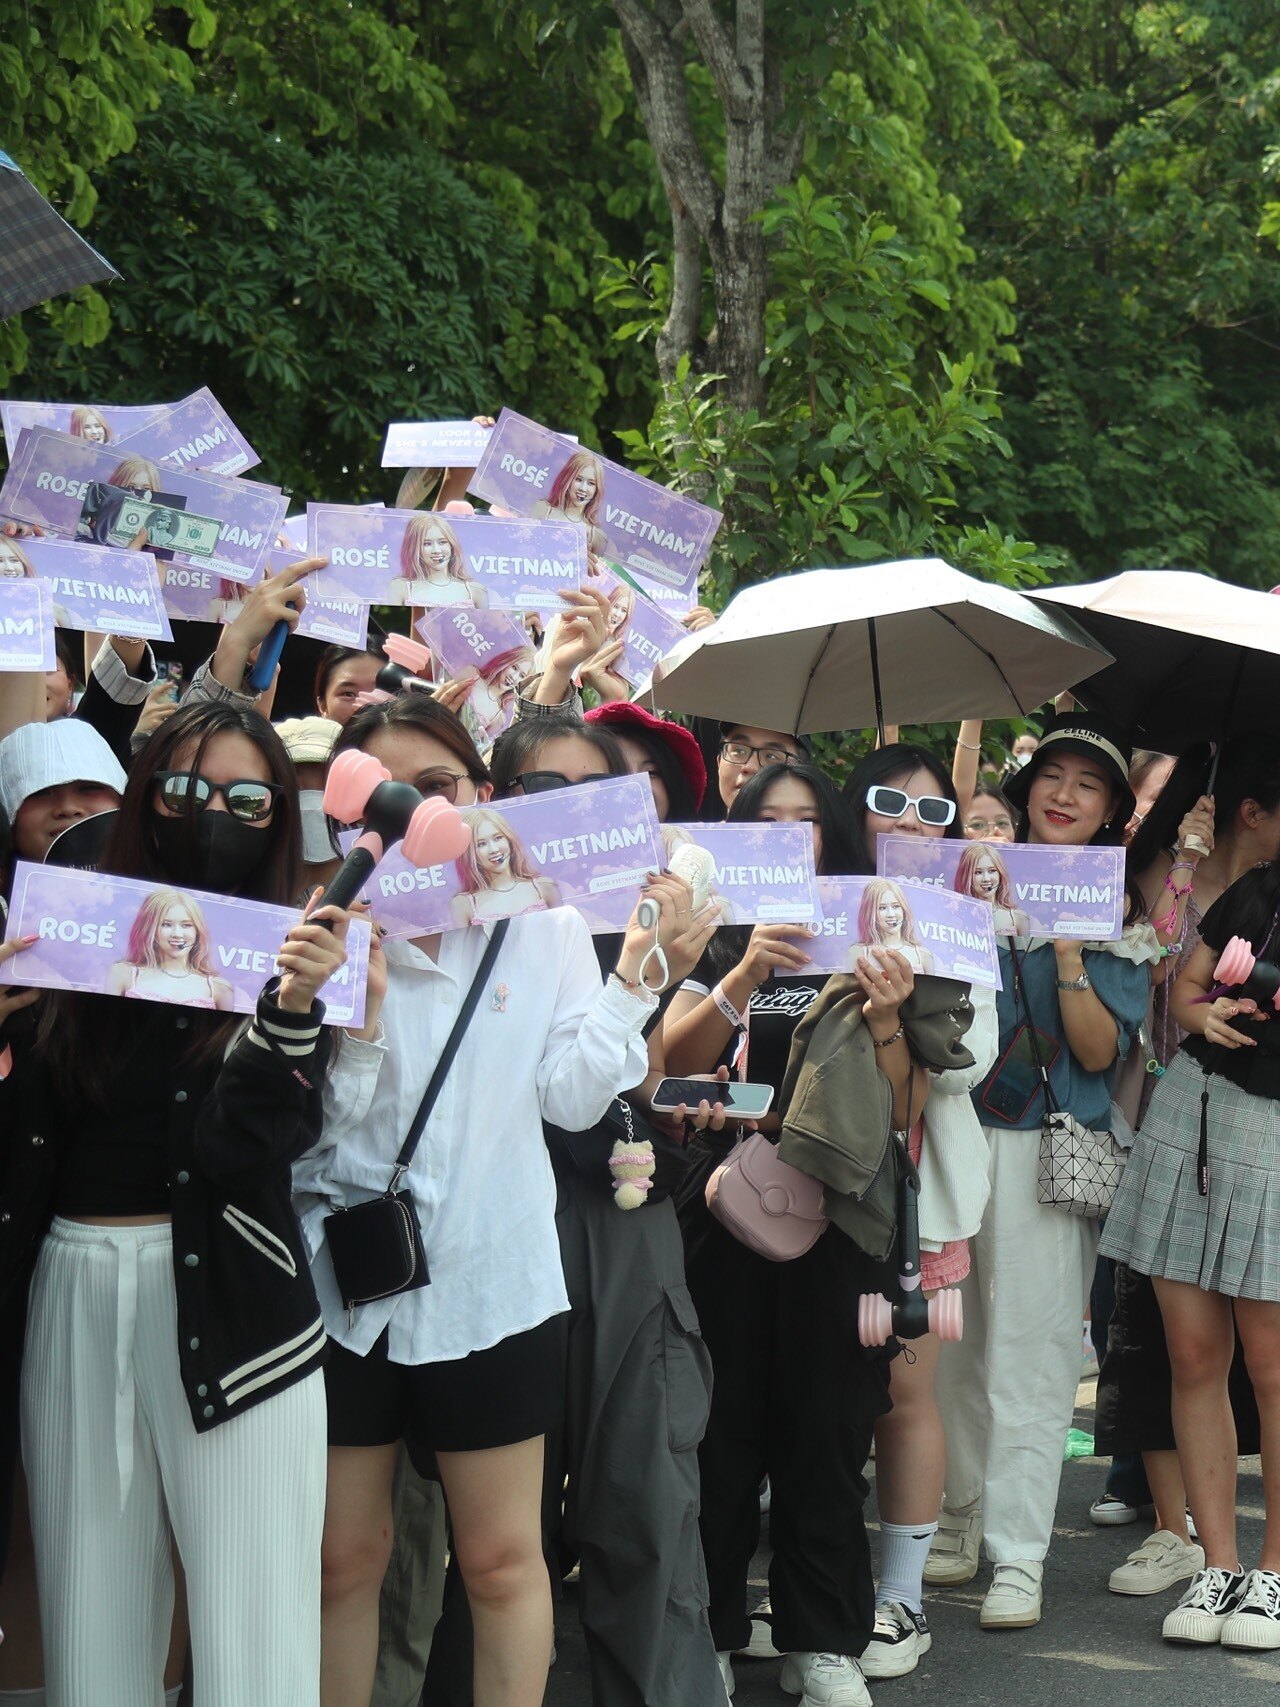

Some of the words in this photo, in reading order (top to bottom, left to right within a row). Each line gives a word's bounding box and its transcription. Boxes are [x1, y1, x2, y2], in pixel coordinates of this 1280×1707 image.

[500, 454, 550, 489] ROSÉ
[604, 504, 696, 558] VIETNAM
[331, 545, 390, 569] ROSÉ
[469, 555, 575, 579] VIETNAM
[452, 612, 495, 657] ROSÉ
[1063, 727, 1103, 742] CELINE
[531, 823, 647, 866] VIETNAM
[713, 864, 804, 887] VIETNAM
[1016, 883, 1111, 904] VIETNAM
[39, 916, 118, 949] ROSÉ
[218, 944, 351, 986] VIETM
[918, 920, 989, 951] VIETNAM
